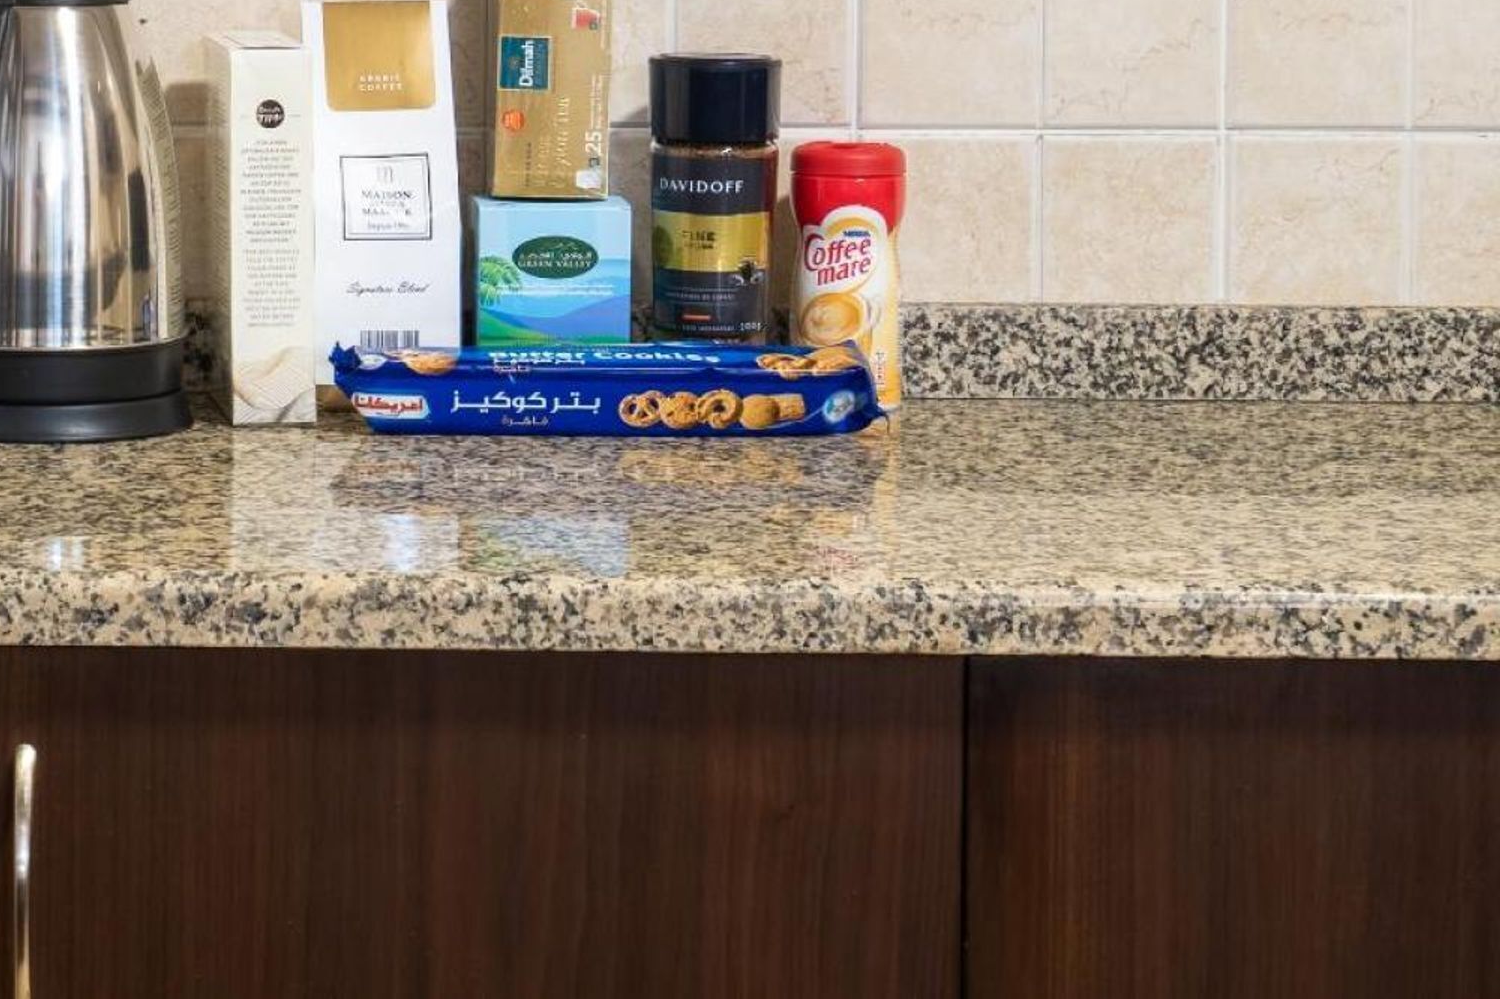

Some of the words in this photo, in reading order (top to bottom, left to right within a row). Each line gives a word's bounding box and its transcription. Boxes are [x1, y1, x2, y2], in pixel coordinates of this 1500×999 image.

[518, 39, 535, 88] Dilmah
[359, 82, 402, 91] COFFEE
[585, 131, 603, 156] 25
[660, 177, 744, 194] DAVIDOFF
[804, 232, 872, 272] Coffee
[450, 389, 547, 414] كوكيز
[549, 391, 601, 415] بتر
